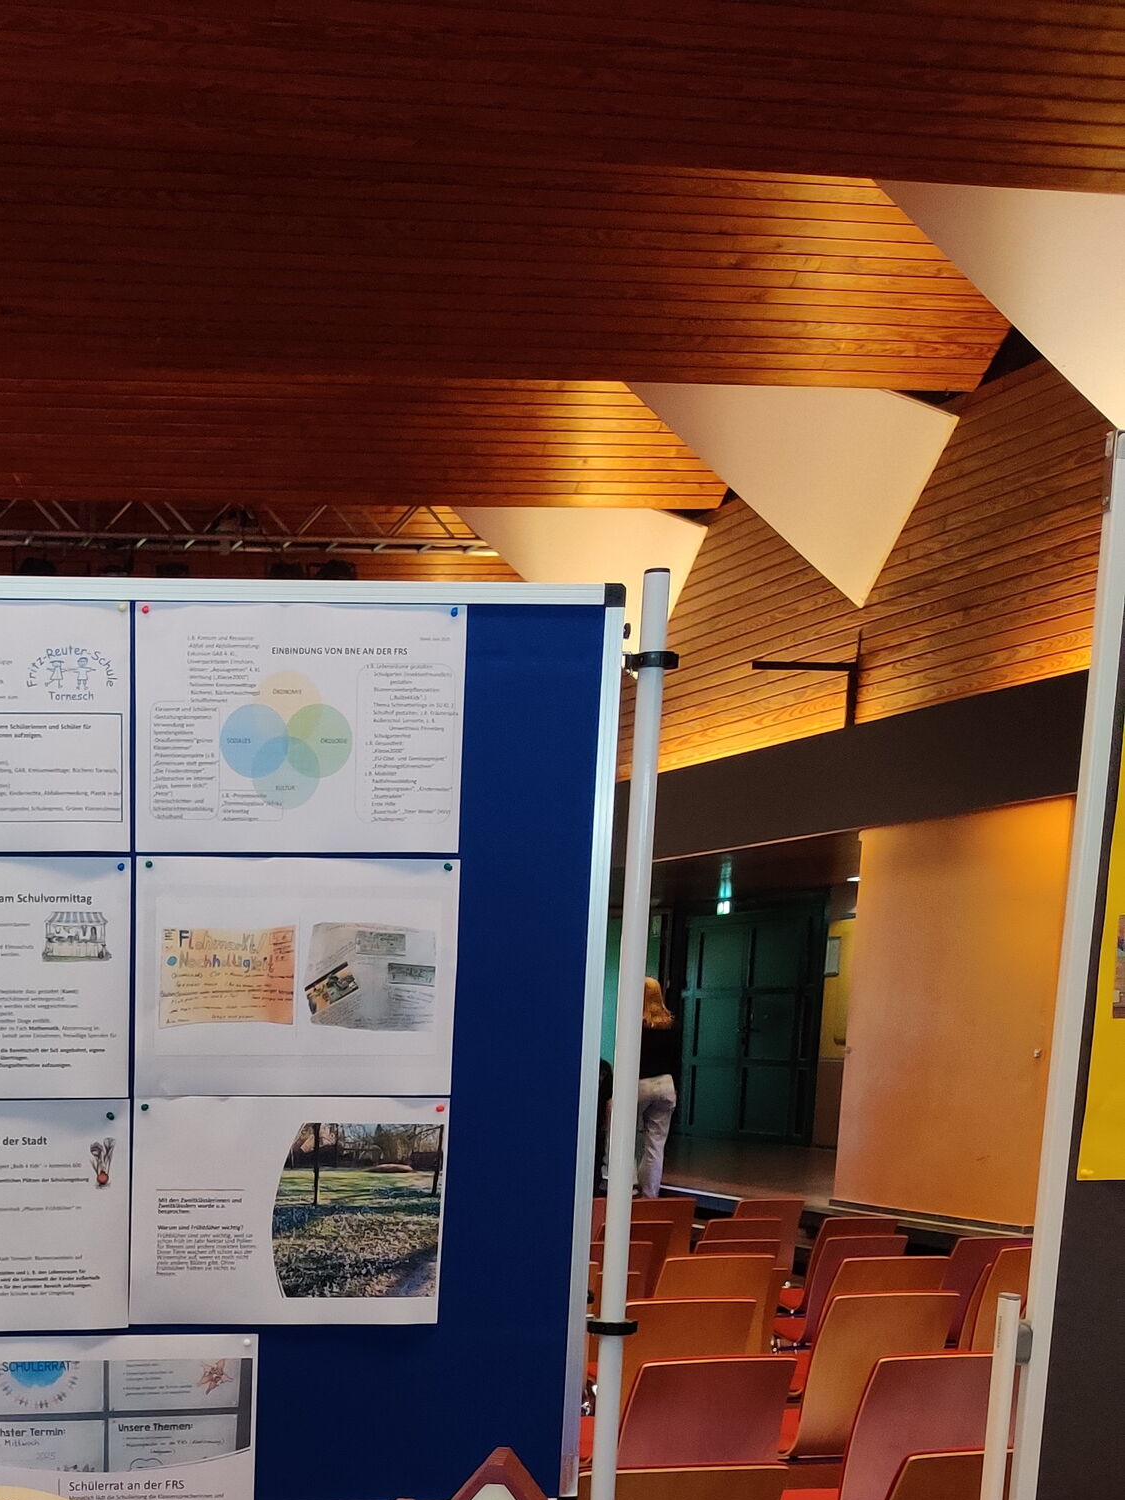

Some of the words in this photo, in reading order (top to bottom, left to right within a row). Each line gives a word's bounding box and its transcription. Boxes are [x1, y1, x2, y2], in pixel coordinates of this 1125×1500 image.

[271, 646, 323, 656] EINBINDUNG
[325, 646, 343, 656] VON
[345, 646, 361, 656] BNE
[363, 646, 375, 656] AN
[376, 646, 392, 656] DER
[393, 646, 408, 656] FRS
[26, 645, 118, 688] Fritz-Reuter-Schule
[48, 690, 94, 701] Tornesch
[17, 893, 92, 905] Schulvormittag
[3, 1137, 19, 1146] der
[22, 1136, 47, 1146] Stadt
[30, 1427, 66, 1436] Termin:
[118, 1423, 150, 1432] Unsere
[153, 1422, 193, 1431] Themen:
[69, 1481, 124, 1492] Schülerrat
[144, 1481, 162, 1490] der
[165, 1480, 184, 1490] FRS
